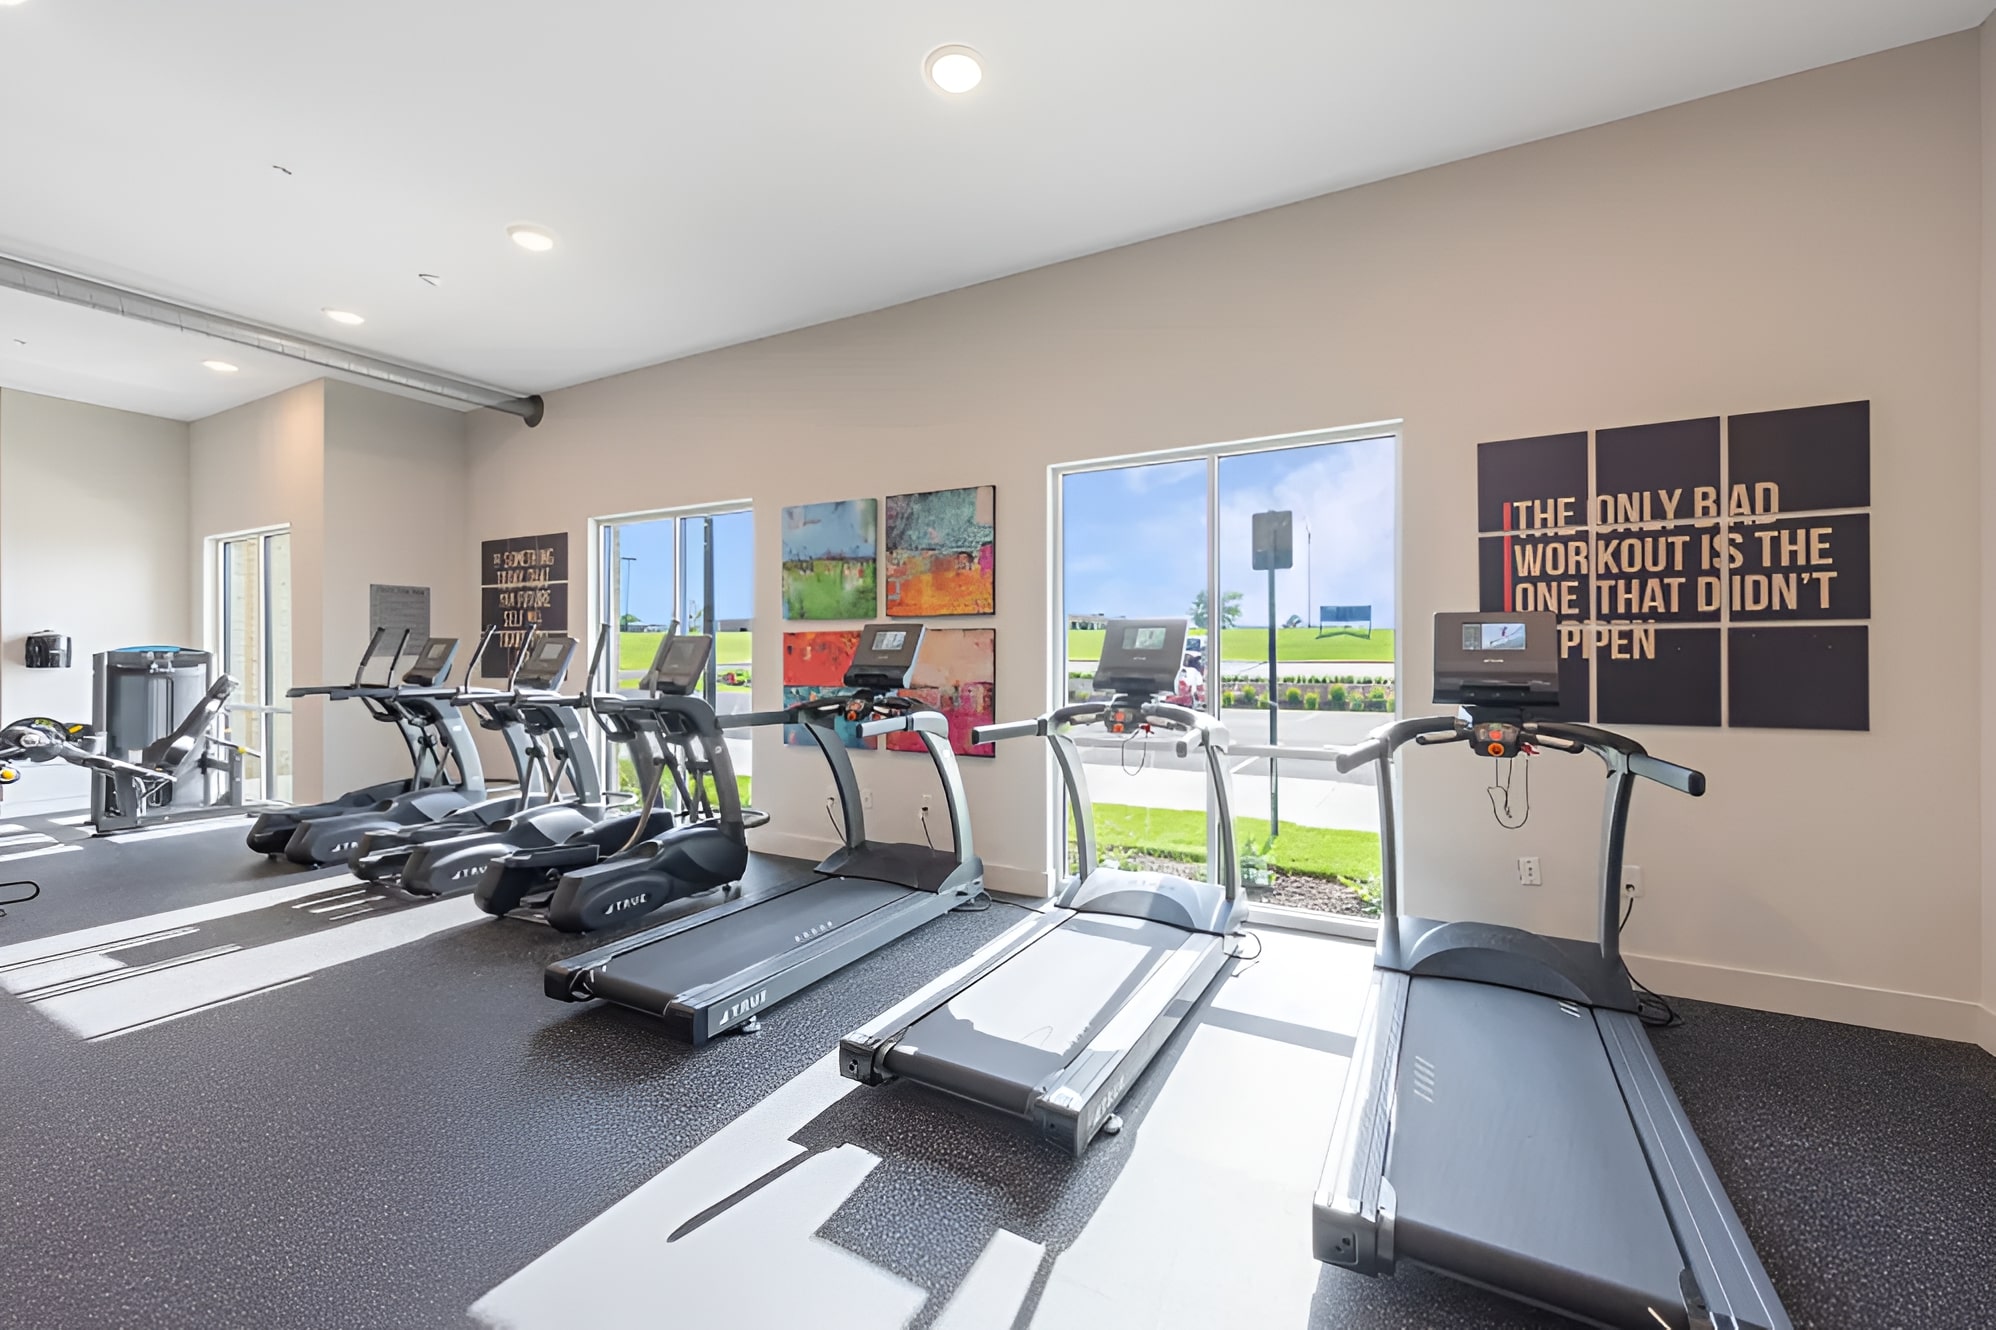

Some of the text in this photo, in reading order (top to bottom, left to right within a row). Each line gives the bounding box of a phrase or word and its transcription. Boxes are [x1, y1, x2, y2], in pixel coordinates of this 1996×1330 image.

[1513, 482, 1779, 538] THE ONLY BAD
[1514, 527, 1833, 577] WORKOUT IS THE
[1515, 571, 1837, 614] ONE THAT DIDN'T
[1560, 619, 1656, 660] PPEN
